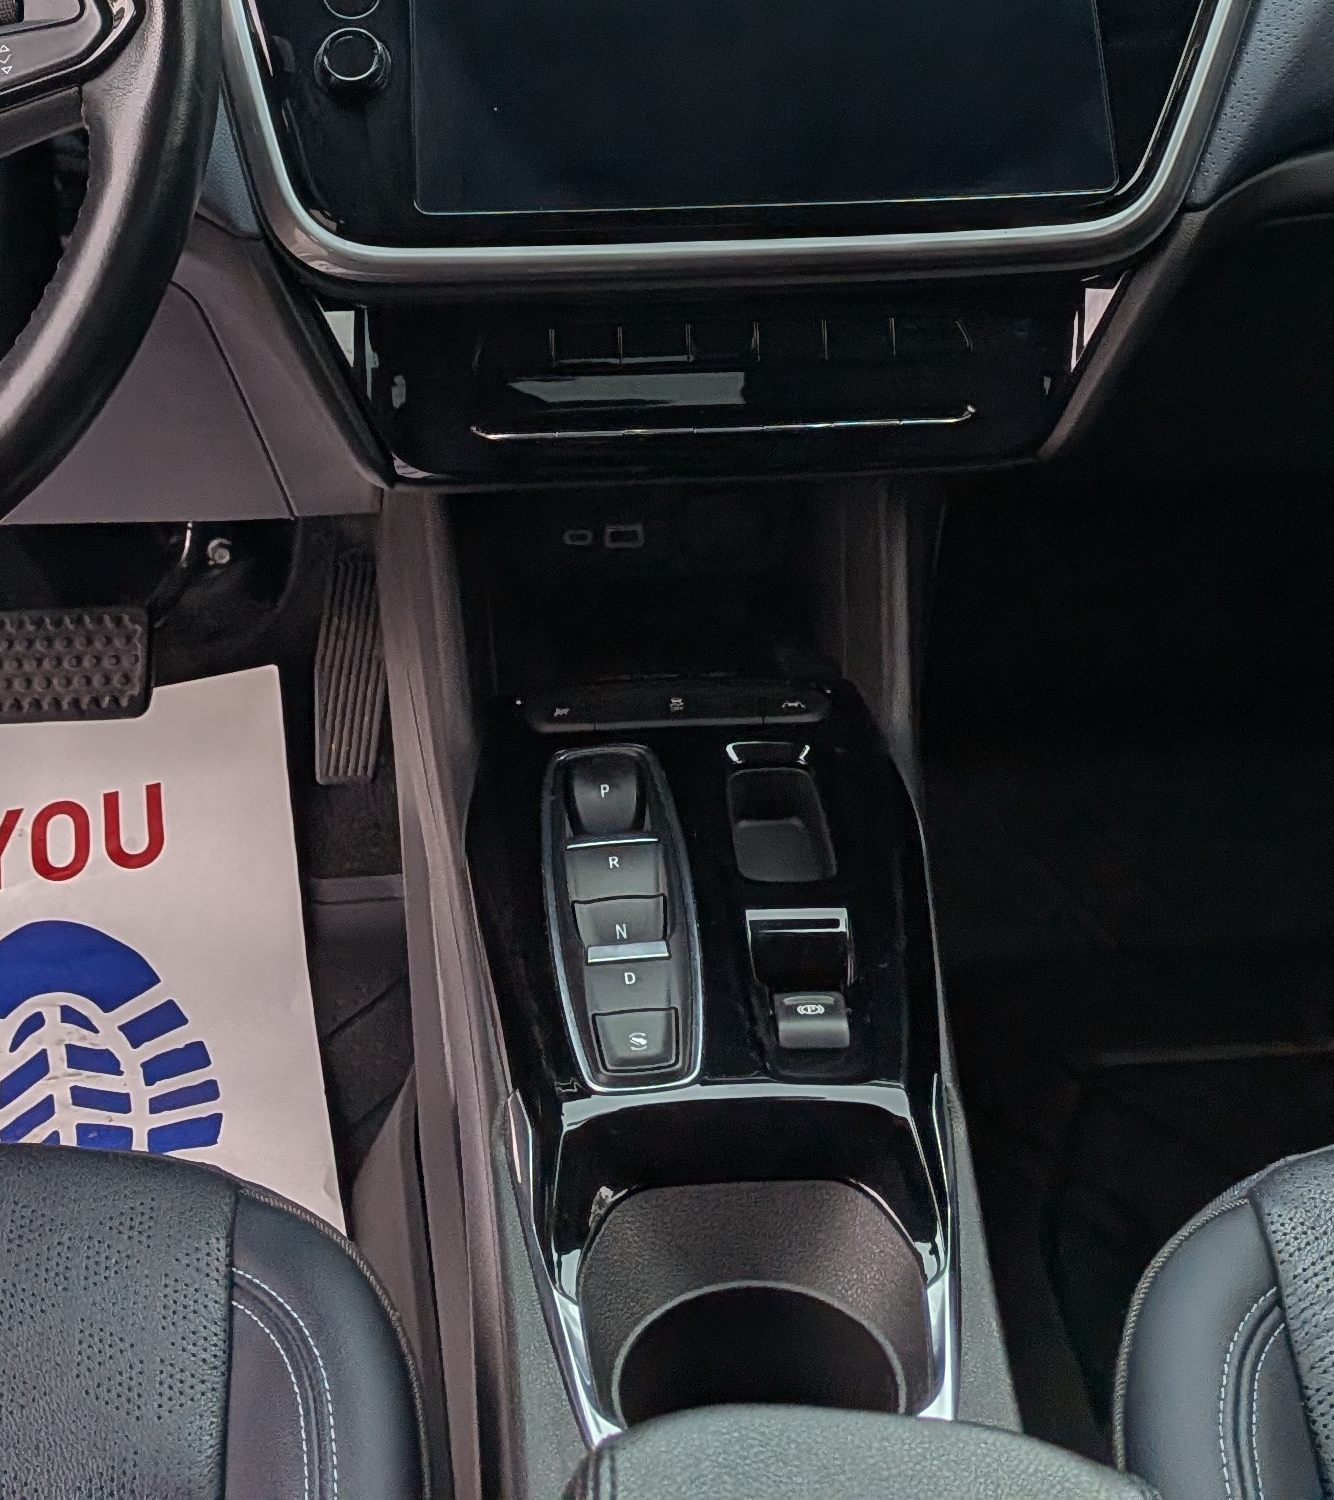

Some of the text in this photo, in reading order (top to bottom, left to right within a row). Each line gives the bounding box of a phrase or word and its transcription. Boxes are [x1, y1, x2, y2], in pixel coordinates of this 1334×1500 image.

[600, 783, 610, 799] P
[608, 855, 620, 869] R
[615, 923, 628, 940] N
[624, 972, 636, 985] D
